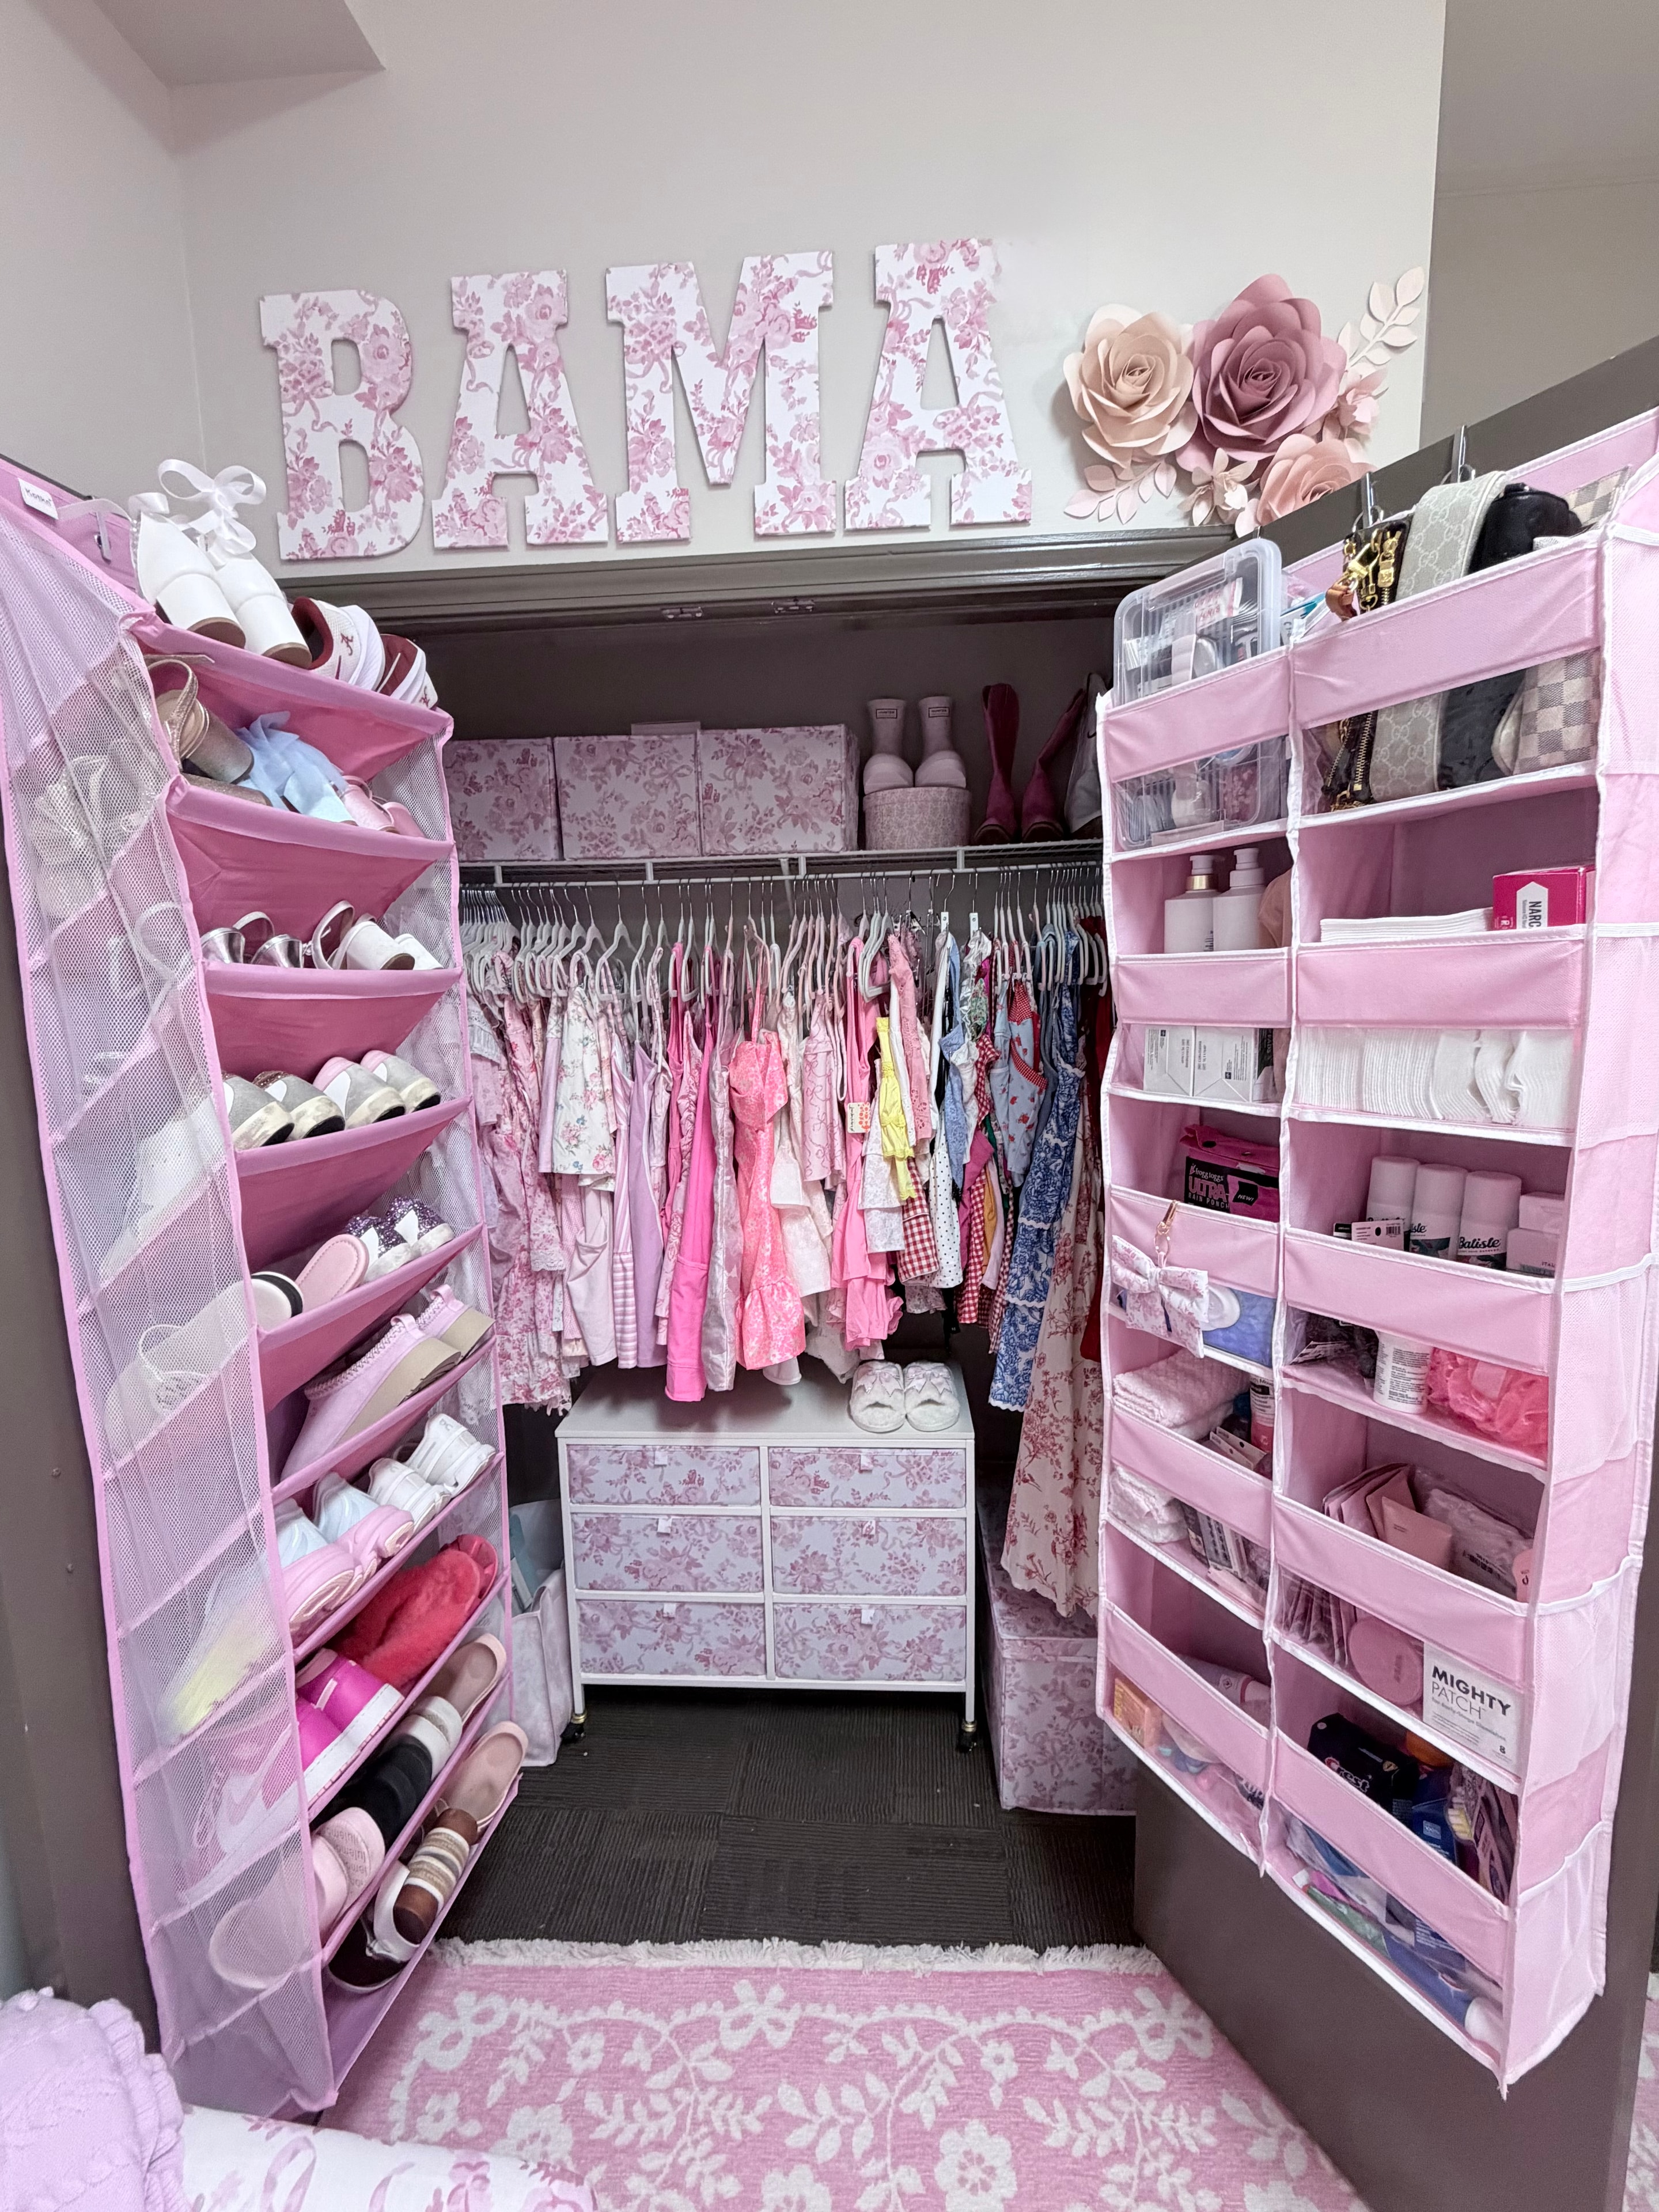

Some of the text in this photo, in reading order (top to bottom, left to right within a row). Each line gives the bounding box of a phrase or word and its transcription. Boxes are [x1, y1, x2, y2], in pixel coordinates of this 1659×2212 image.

[259, 238, 1033, 561] BAMA
[1528, 900, 1542, 929] NARC
[1188, 1192, 1229, 1210] RAIN PONCH
[1237, 1194, 1255, 1202] NEW!
[1431, 1665, 1512, 1717] MIGHTY
[1431, 1681, 1482, 1719] PATCH
[1499, 1745, 1506, 1754] 8
